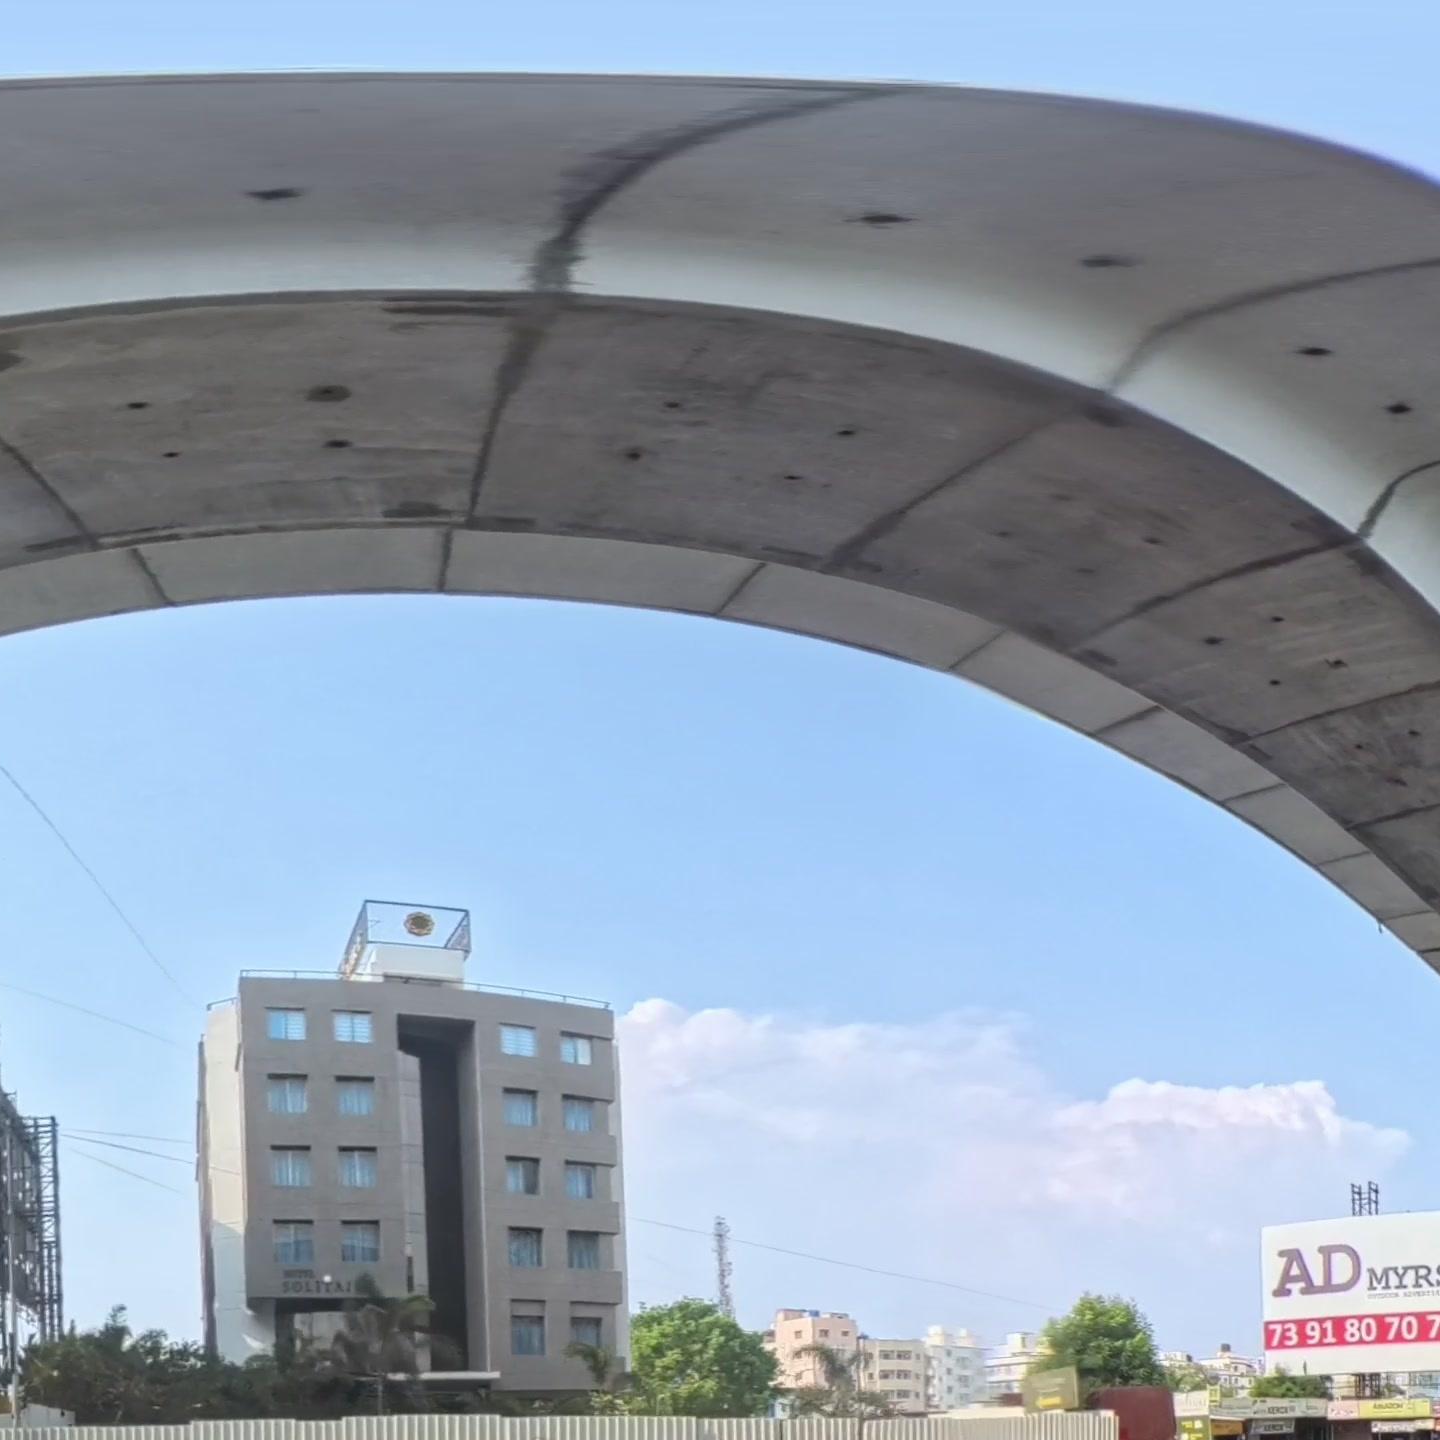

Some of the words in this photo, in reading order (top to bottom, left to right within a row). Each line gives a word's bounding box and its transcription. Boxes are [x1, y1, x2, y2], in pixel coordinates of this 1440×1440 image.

[1272, 1244, 1361, 1297] AD
[1269, 1322, 1299, 1347] 73
[1305, 1320, 1337, 1345] 91
[1344, 1317, 1377, 1342] 80
[1384, 1315, 1418, 1341] 70
